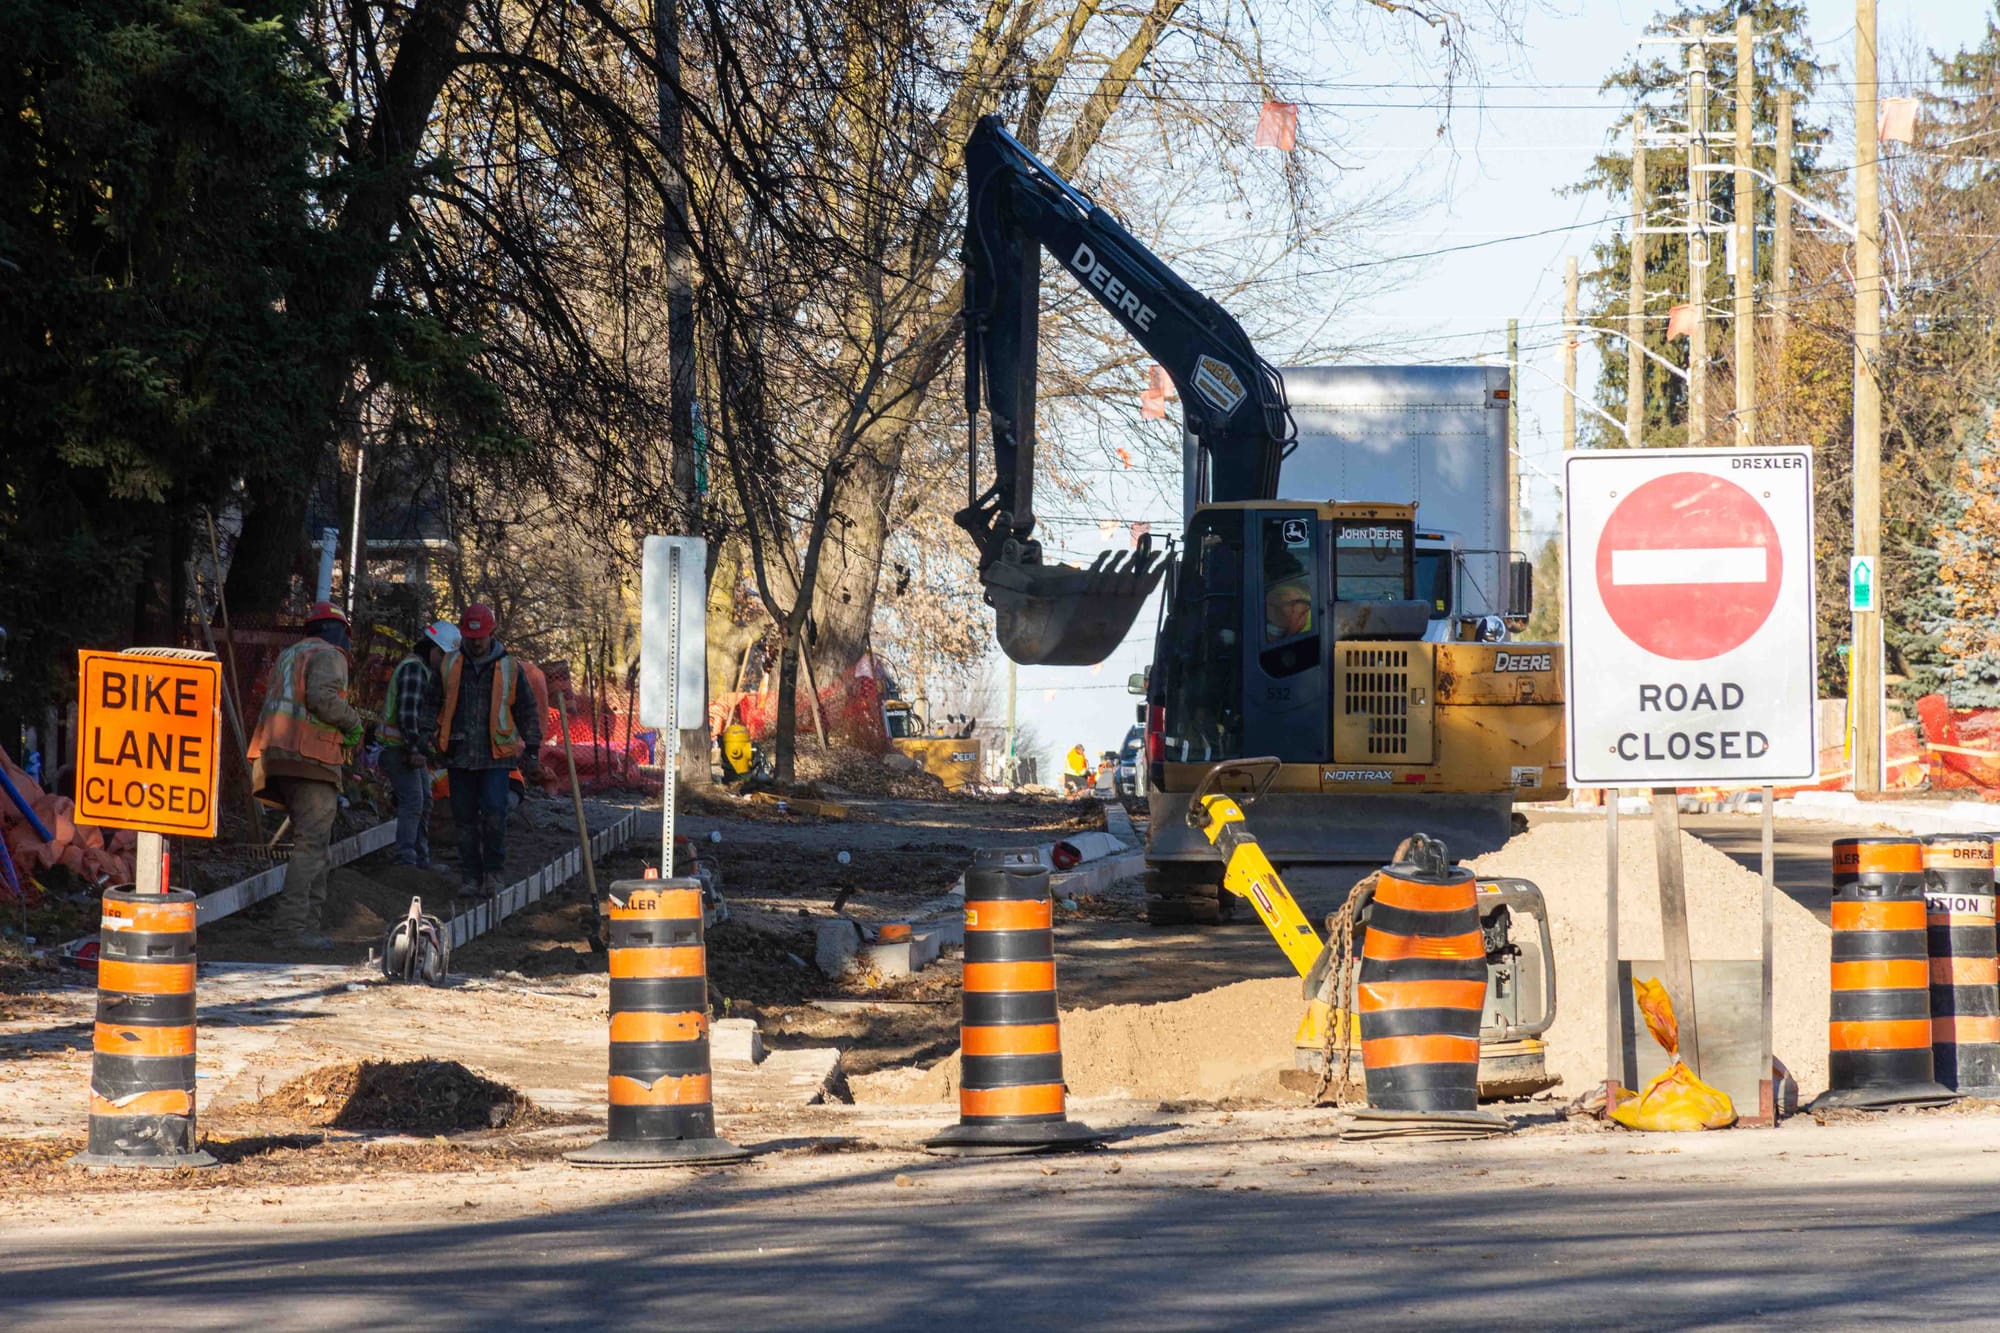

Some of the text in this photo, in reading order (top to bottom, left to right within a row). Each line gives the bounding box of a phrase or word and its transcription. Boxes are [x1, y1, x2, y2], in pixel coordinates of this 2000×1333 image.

[1071, 242, 1157, 332] DEERE
[1732, 458, 1802, 469] DREXLER
[1340, 527, 1404, 540] JOHN DEERE
[1494, 652, 1552, 672] DEERE
[102, 671, 198, 717] BIKE
[1639, 682, 1744, 711] ROAD
[94, 727, 202, 774] LANE
[1617, 731, 1769, 761] CLOSED
[1324, 770, 1393, 781] NORTRAX
[86, 777, 206, 814] CLOSED
